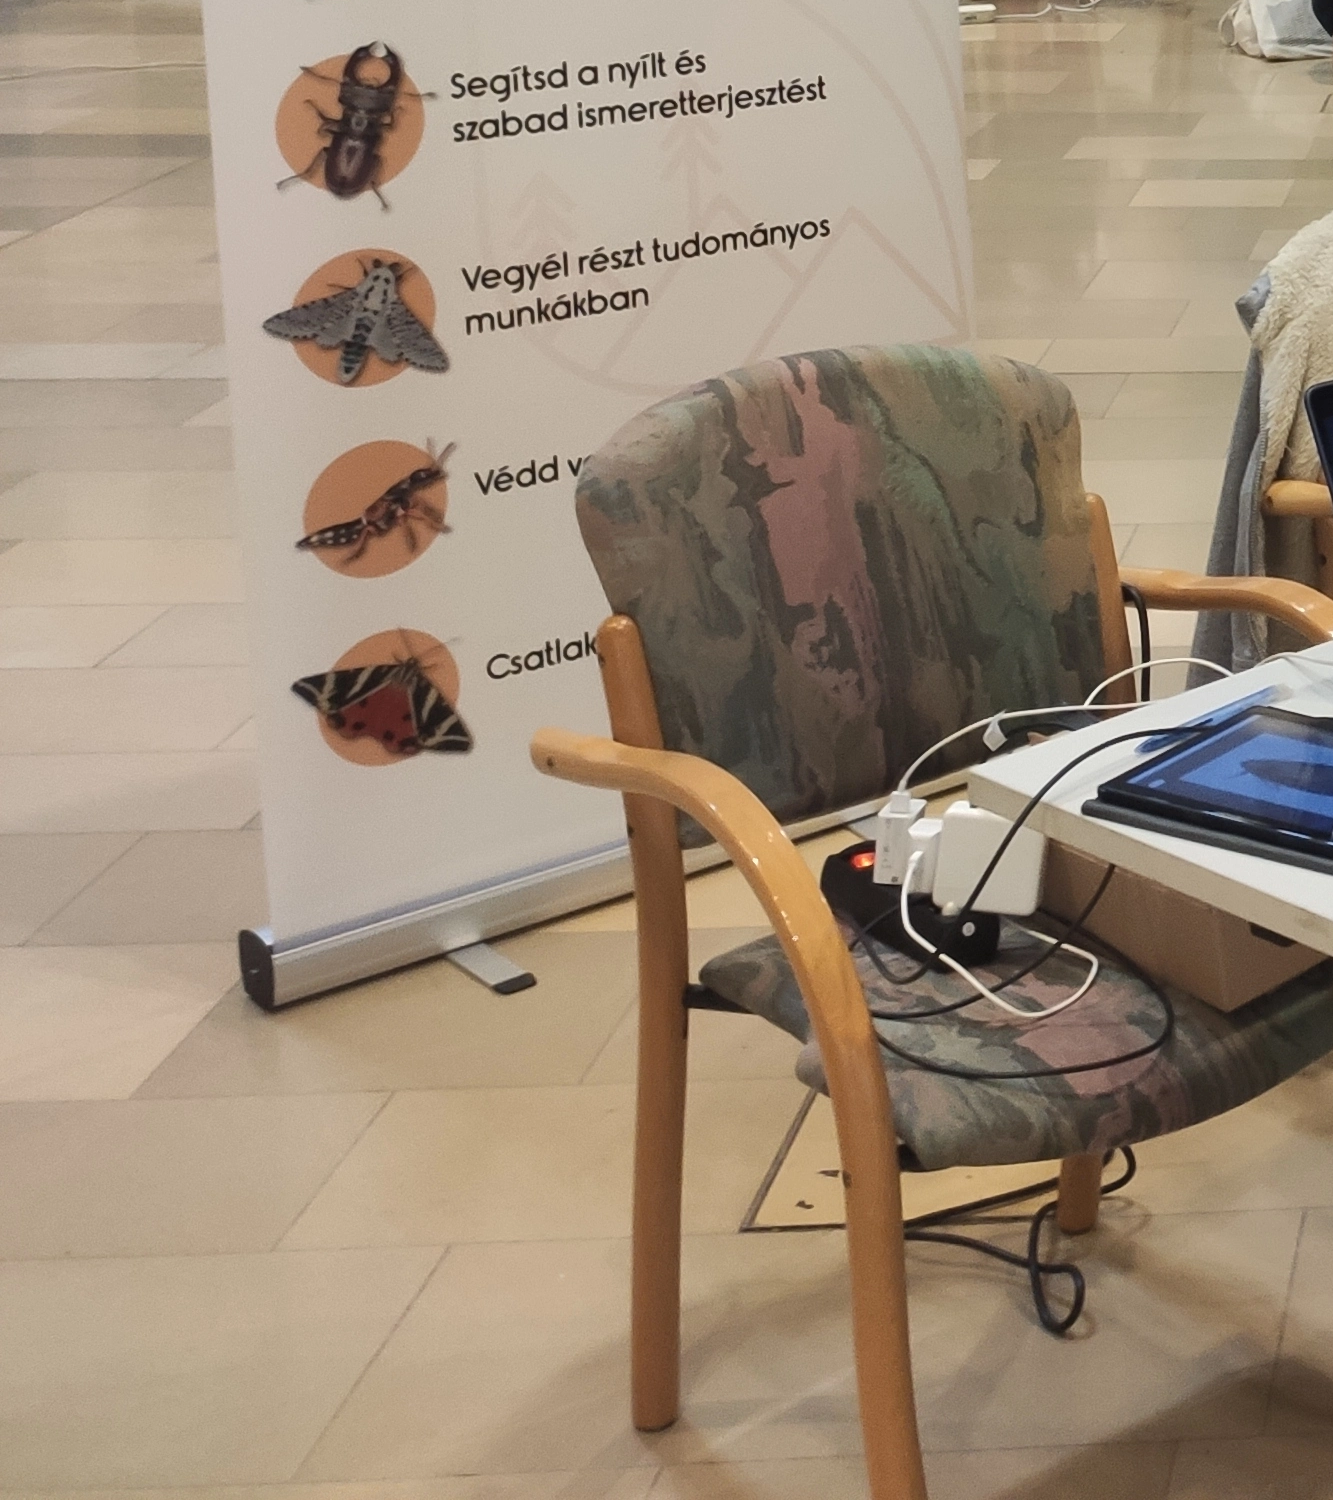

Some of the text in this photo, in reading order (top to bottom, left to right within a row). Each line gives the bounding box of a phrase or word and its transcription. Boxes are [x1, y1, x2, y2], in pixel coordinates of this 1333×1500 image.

[450, 49, 706, 102] Segítsd a nyílt és
[452, 76, 828, 143] szabad ismeretterjesztést
[461, 218, 831, 294] Vegyél részt tudományos
[464, 286, 650, 335] munkákban
[473, 454, 560, 496] Védd
